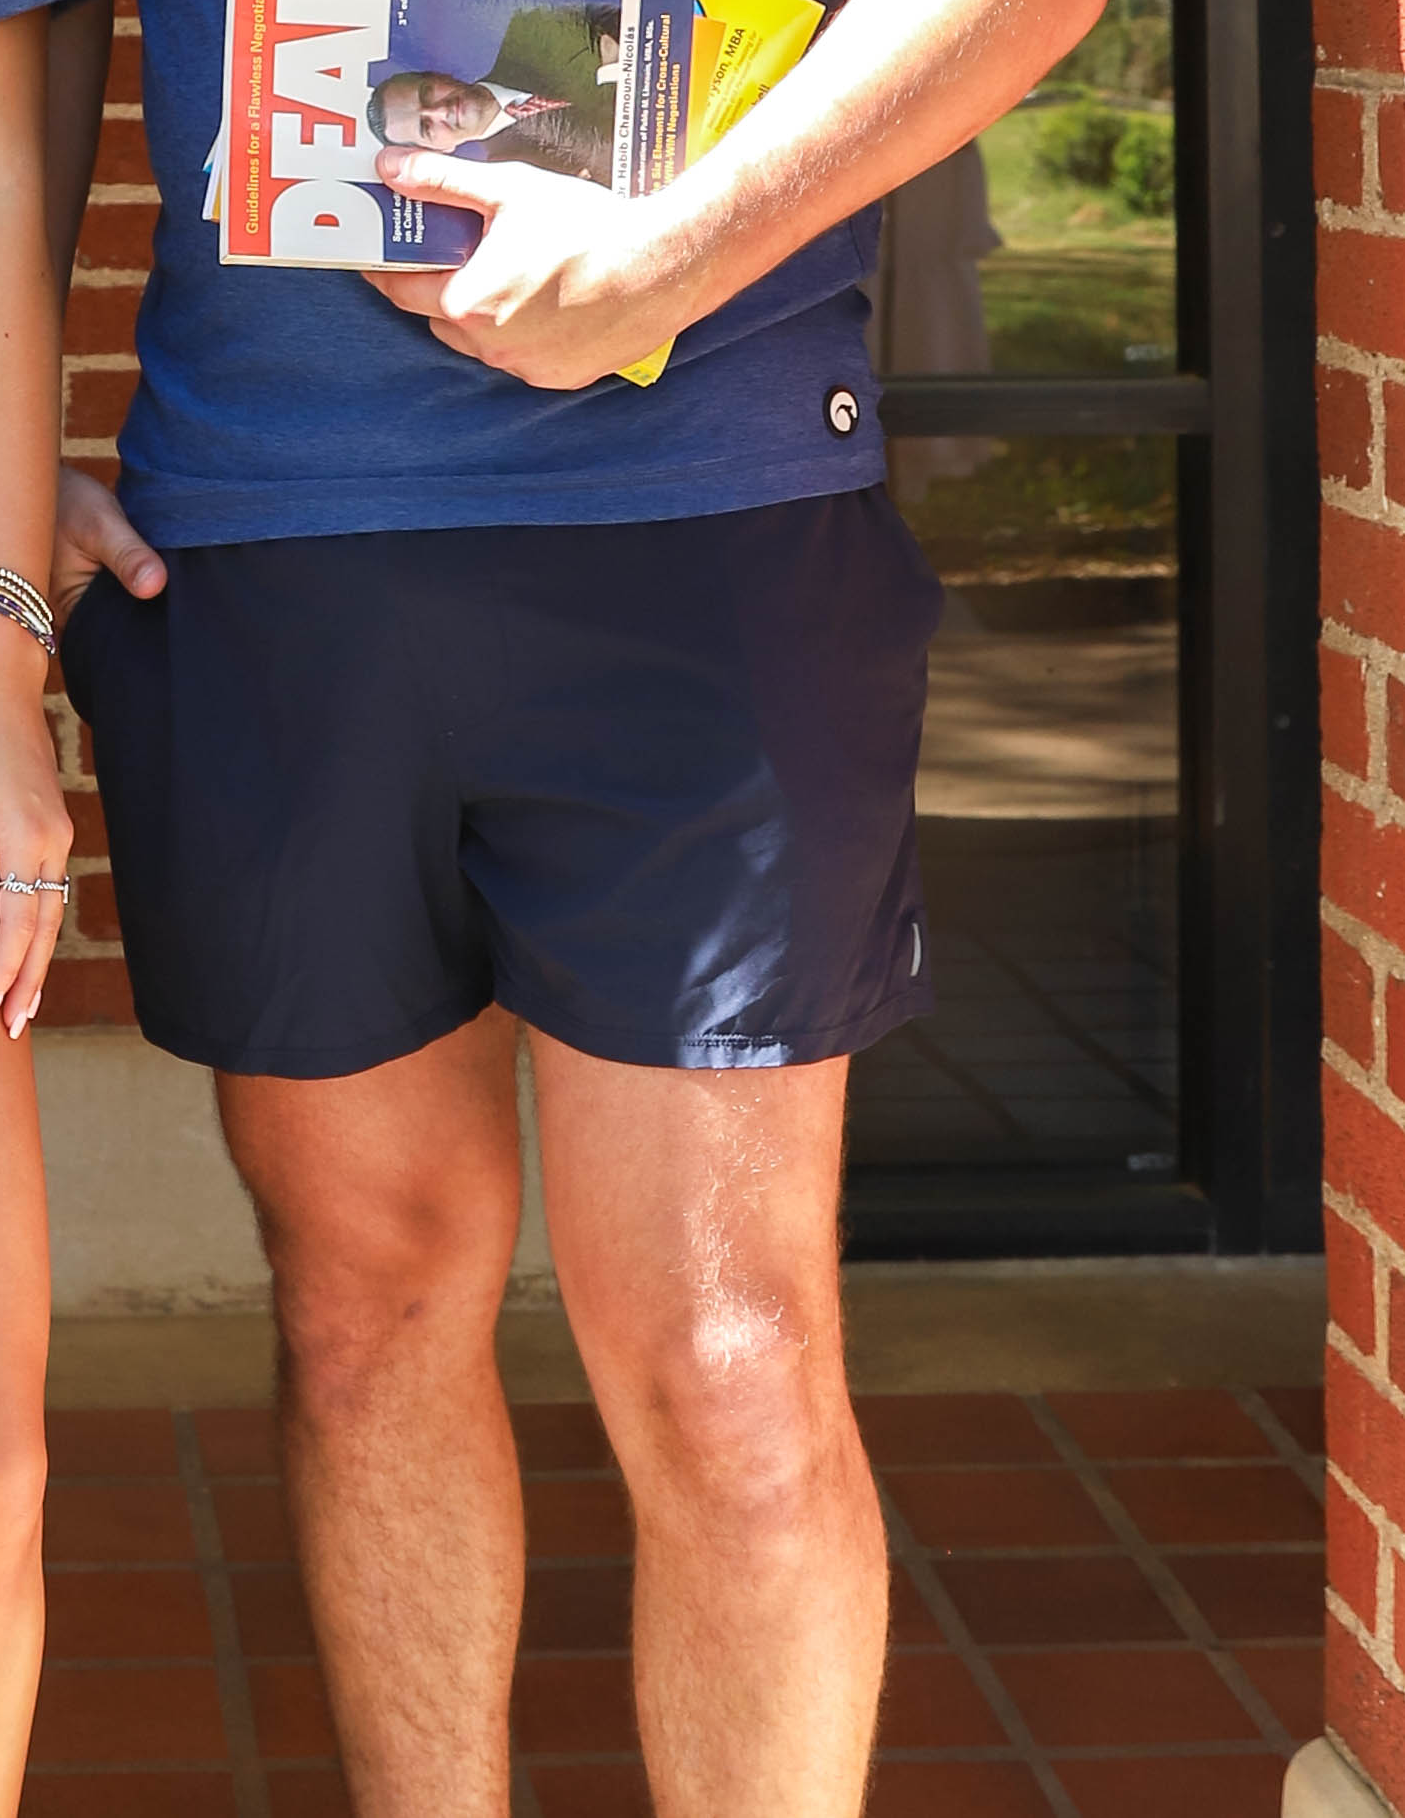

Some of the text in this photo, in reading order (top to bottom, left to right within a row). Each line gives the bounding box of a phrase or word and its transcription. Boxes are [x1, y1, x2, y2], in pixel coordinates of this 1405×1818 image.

[656, 14, 671, 91] Cross-Cultural
[724, 28, 745, 58] MBA
[248, 56, 263, 118] Flawless
[619, 26, 636, 138] Chamoun-Nicolás
[655, 93, 666, 109] for
[666, 64, 681, 132] Negotiations
[246, 133, 260, 155] for
[250, 122, 260, 131] a
[652, 111, 666, 159] Elements
[617, 142, 629, 179] Habib
[245, 157, 260, 234] Guidelines
[392, 206, 403, 243] Special
